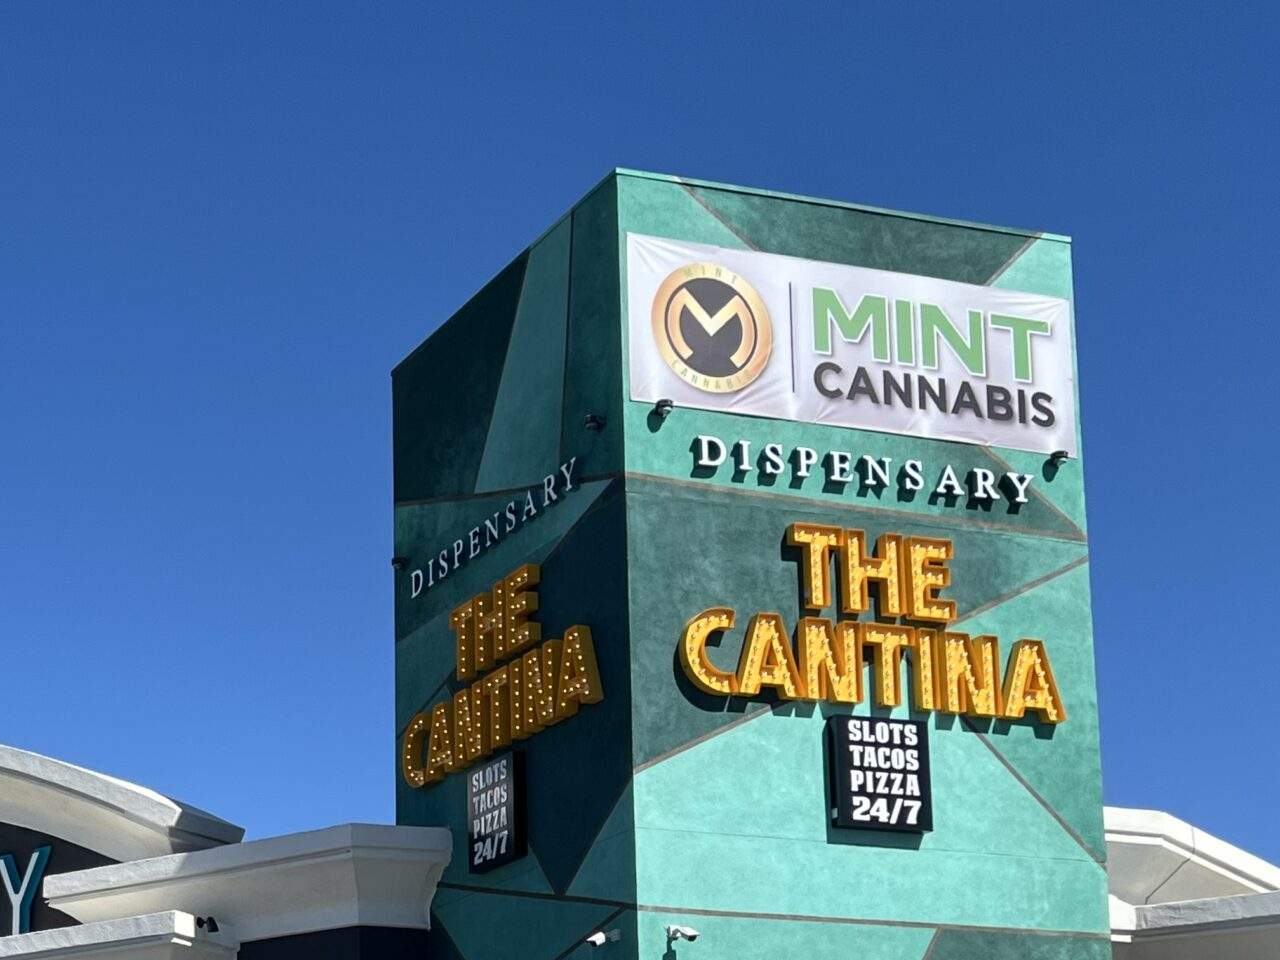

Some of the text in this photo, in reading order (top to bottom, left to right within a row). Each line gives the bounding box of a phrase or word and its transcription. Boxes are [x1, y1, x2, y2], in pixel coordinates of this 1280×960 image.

[811, 285, 1052, 383] MINT
[813, 362, 1055, 428] CANNABIS
[697, 434, 1035, 504] DISPENSARY
[410, 456, 578, 599] DISPENSARY
[787, 521, 958, 622] THE
[449, 563, 541, 681] THE
[678, 606, 1067, 724] CANTINA
[402, 625, 604, 789] CANTINA
[847, 719, 919, 747] SLOTS
[849, 745, 920, 771] TACOS
[472, 758, 508, 793] SLOTS
[472, 783, 509, 815] TACOS
[850, 769, 921, 797] PIZZA
[473, 811, 509, 840] PIZZA
[852, 796, 922, 826] 24/7
[473, 830, 509, 866] 24/7
